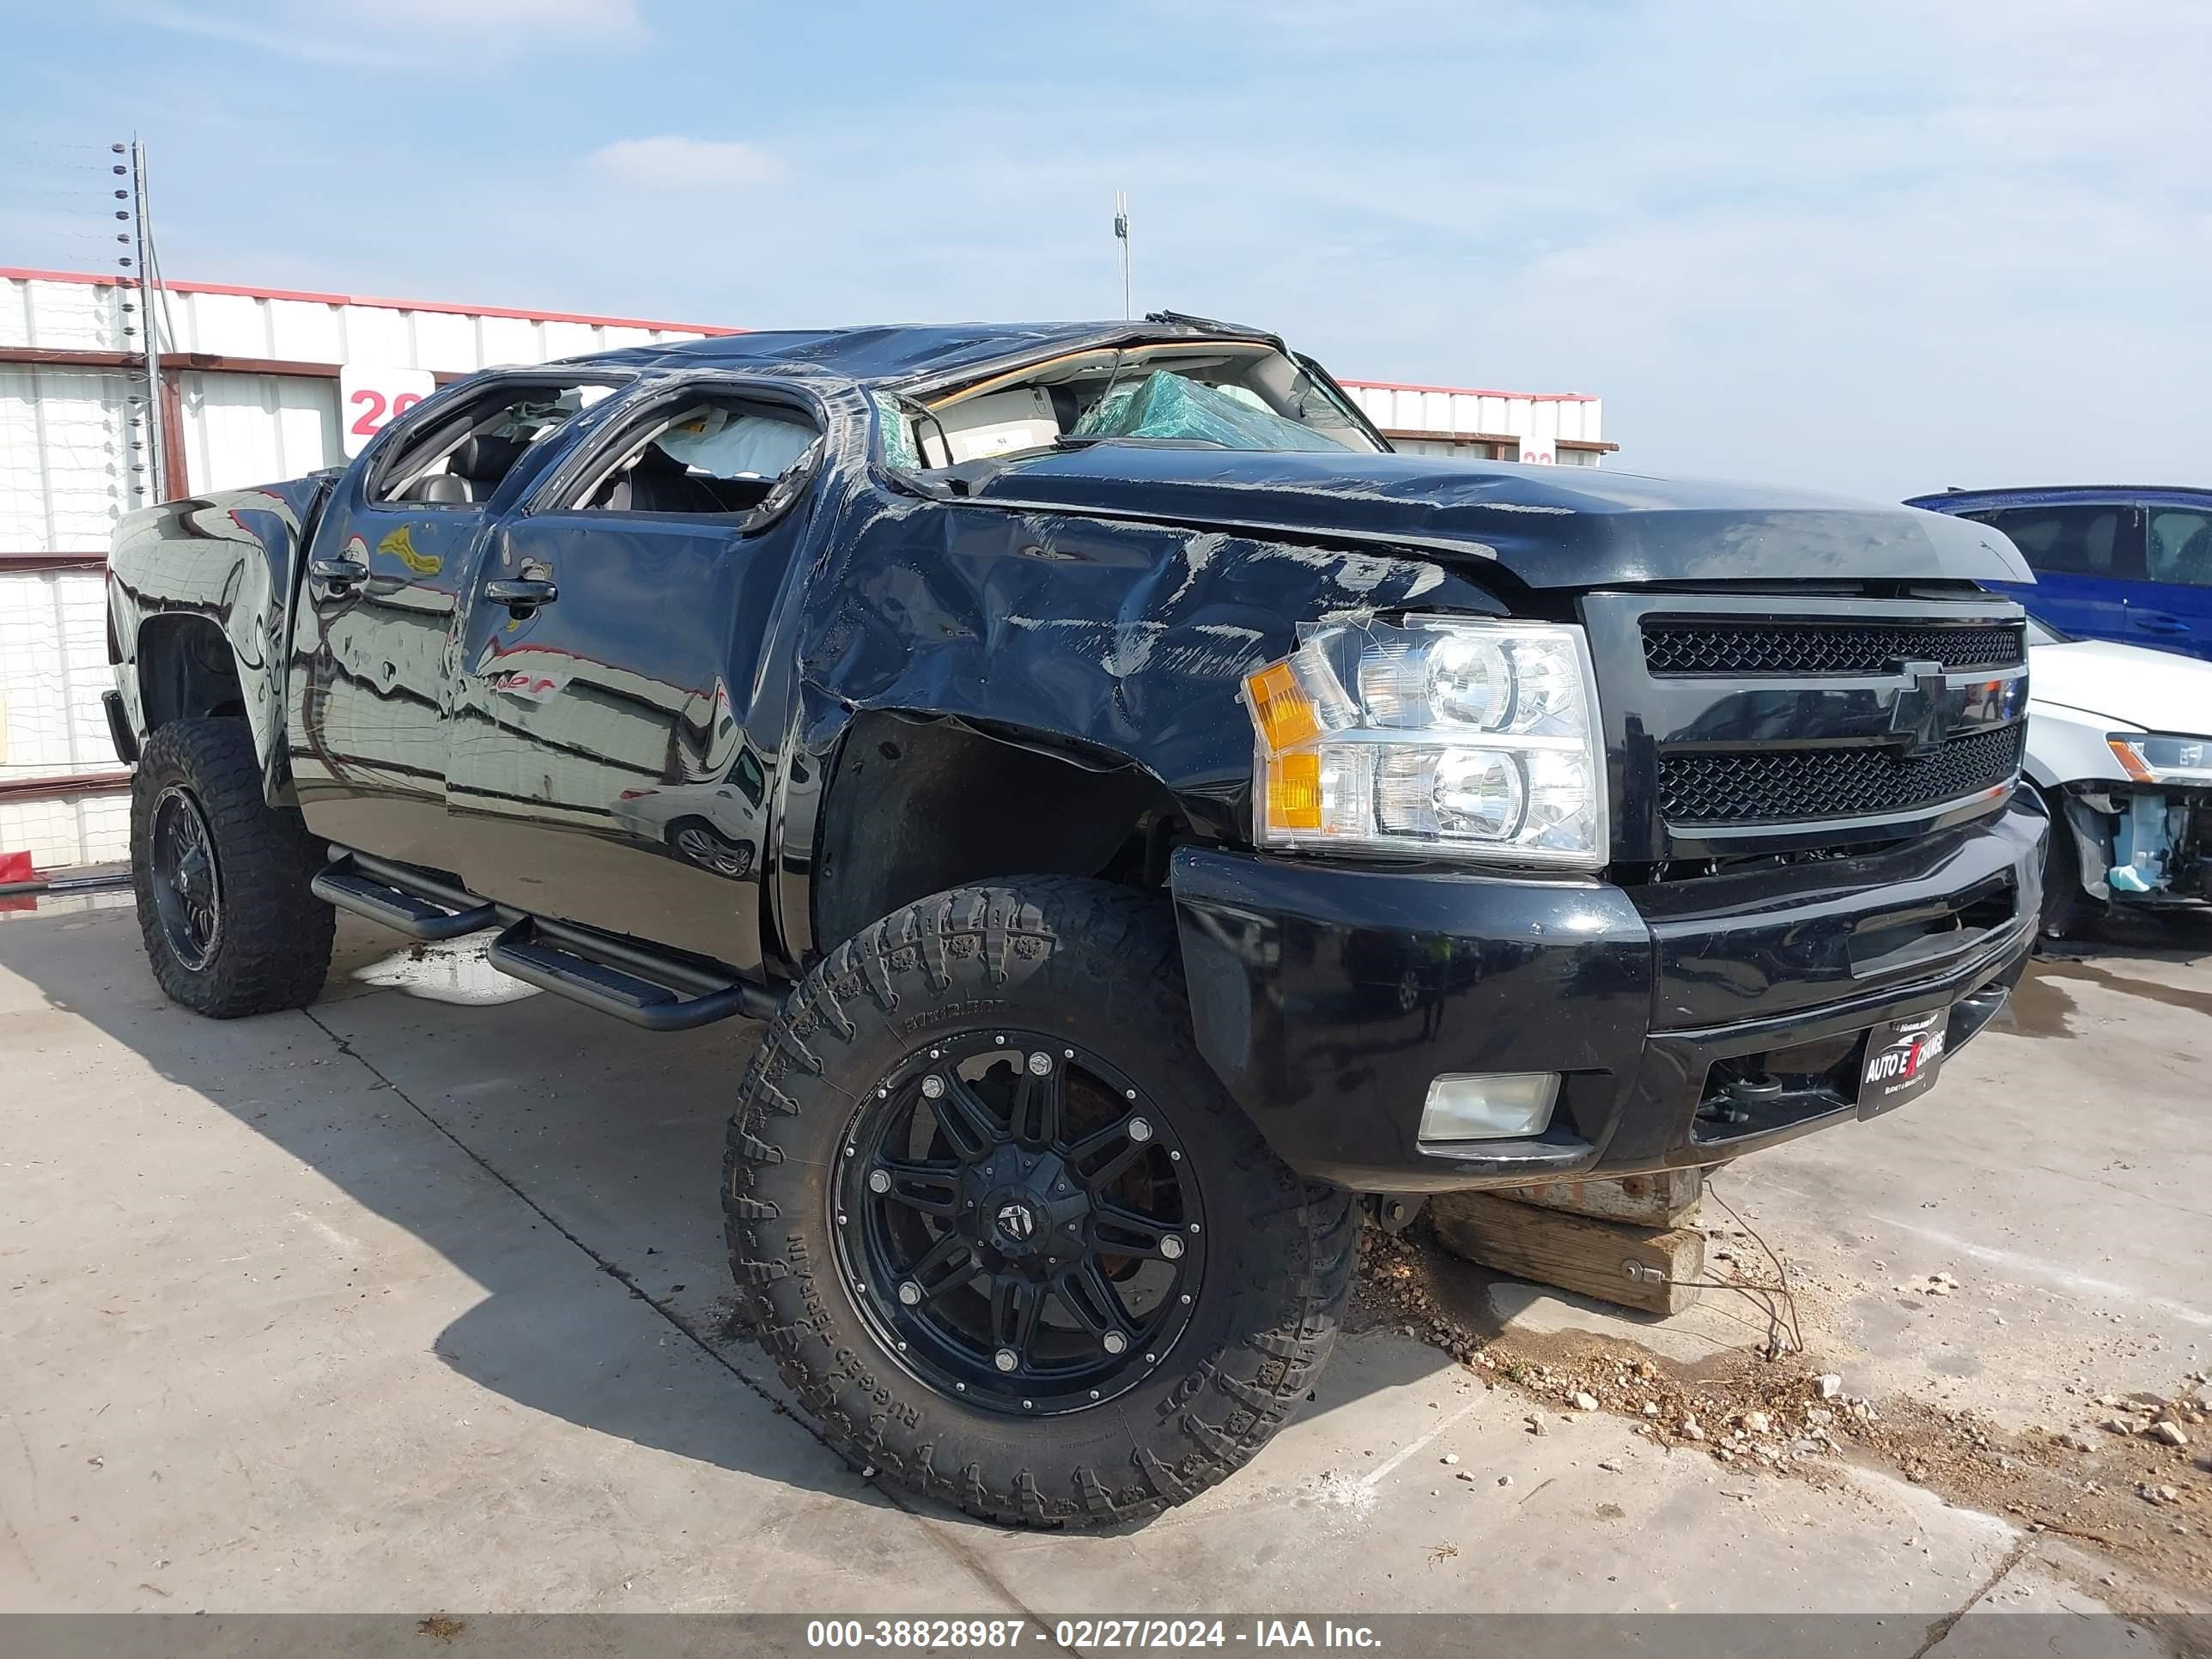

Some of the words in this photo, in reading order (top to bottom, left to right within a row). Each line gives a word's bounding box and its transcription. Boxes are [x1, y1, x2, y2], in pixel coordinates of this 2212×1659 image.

[1865, 1052, 1899, 1084] AUTO
[1899, 1030, 1945, 1078] EXCHANGE
[998, 1220, 1022, 1241] FUEL
[787, 1234, 841, 1347] TERRAIN
[836, 1346, 923, 1429] RUGGED
